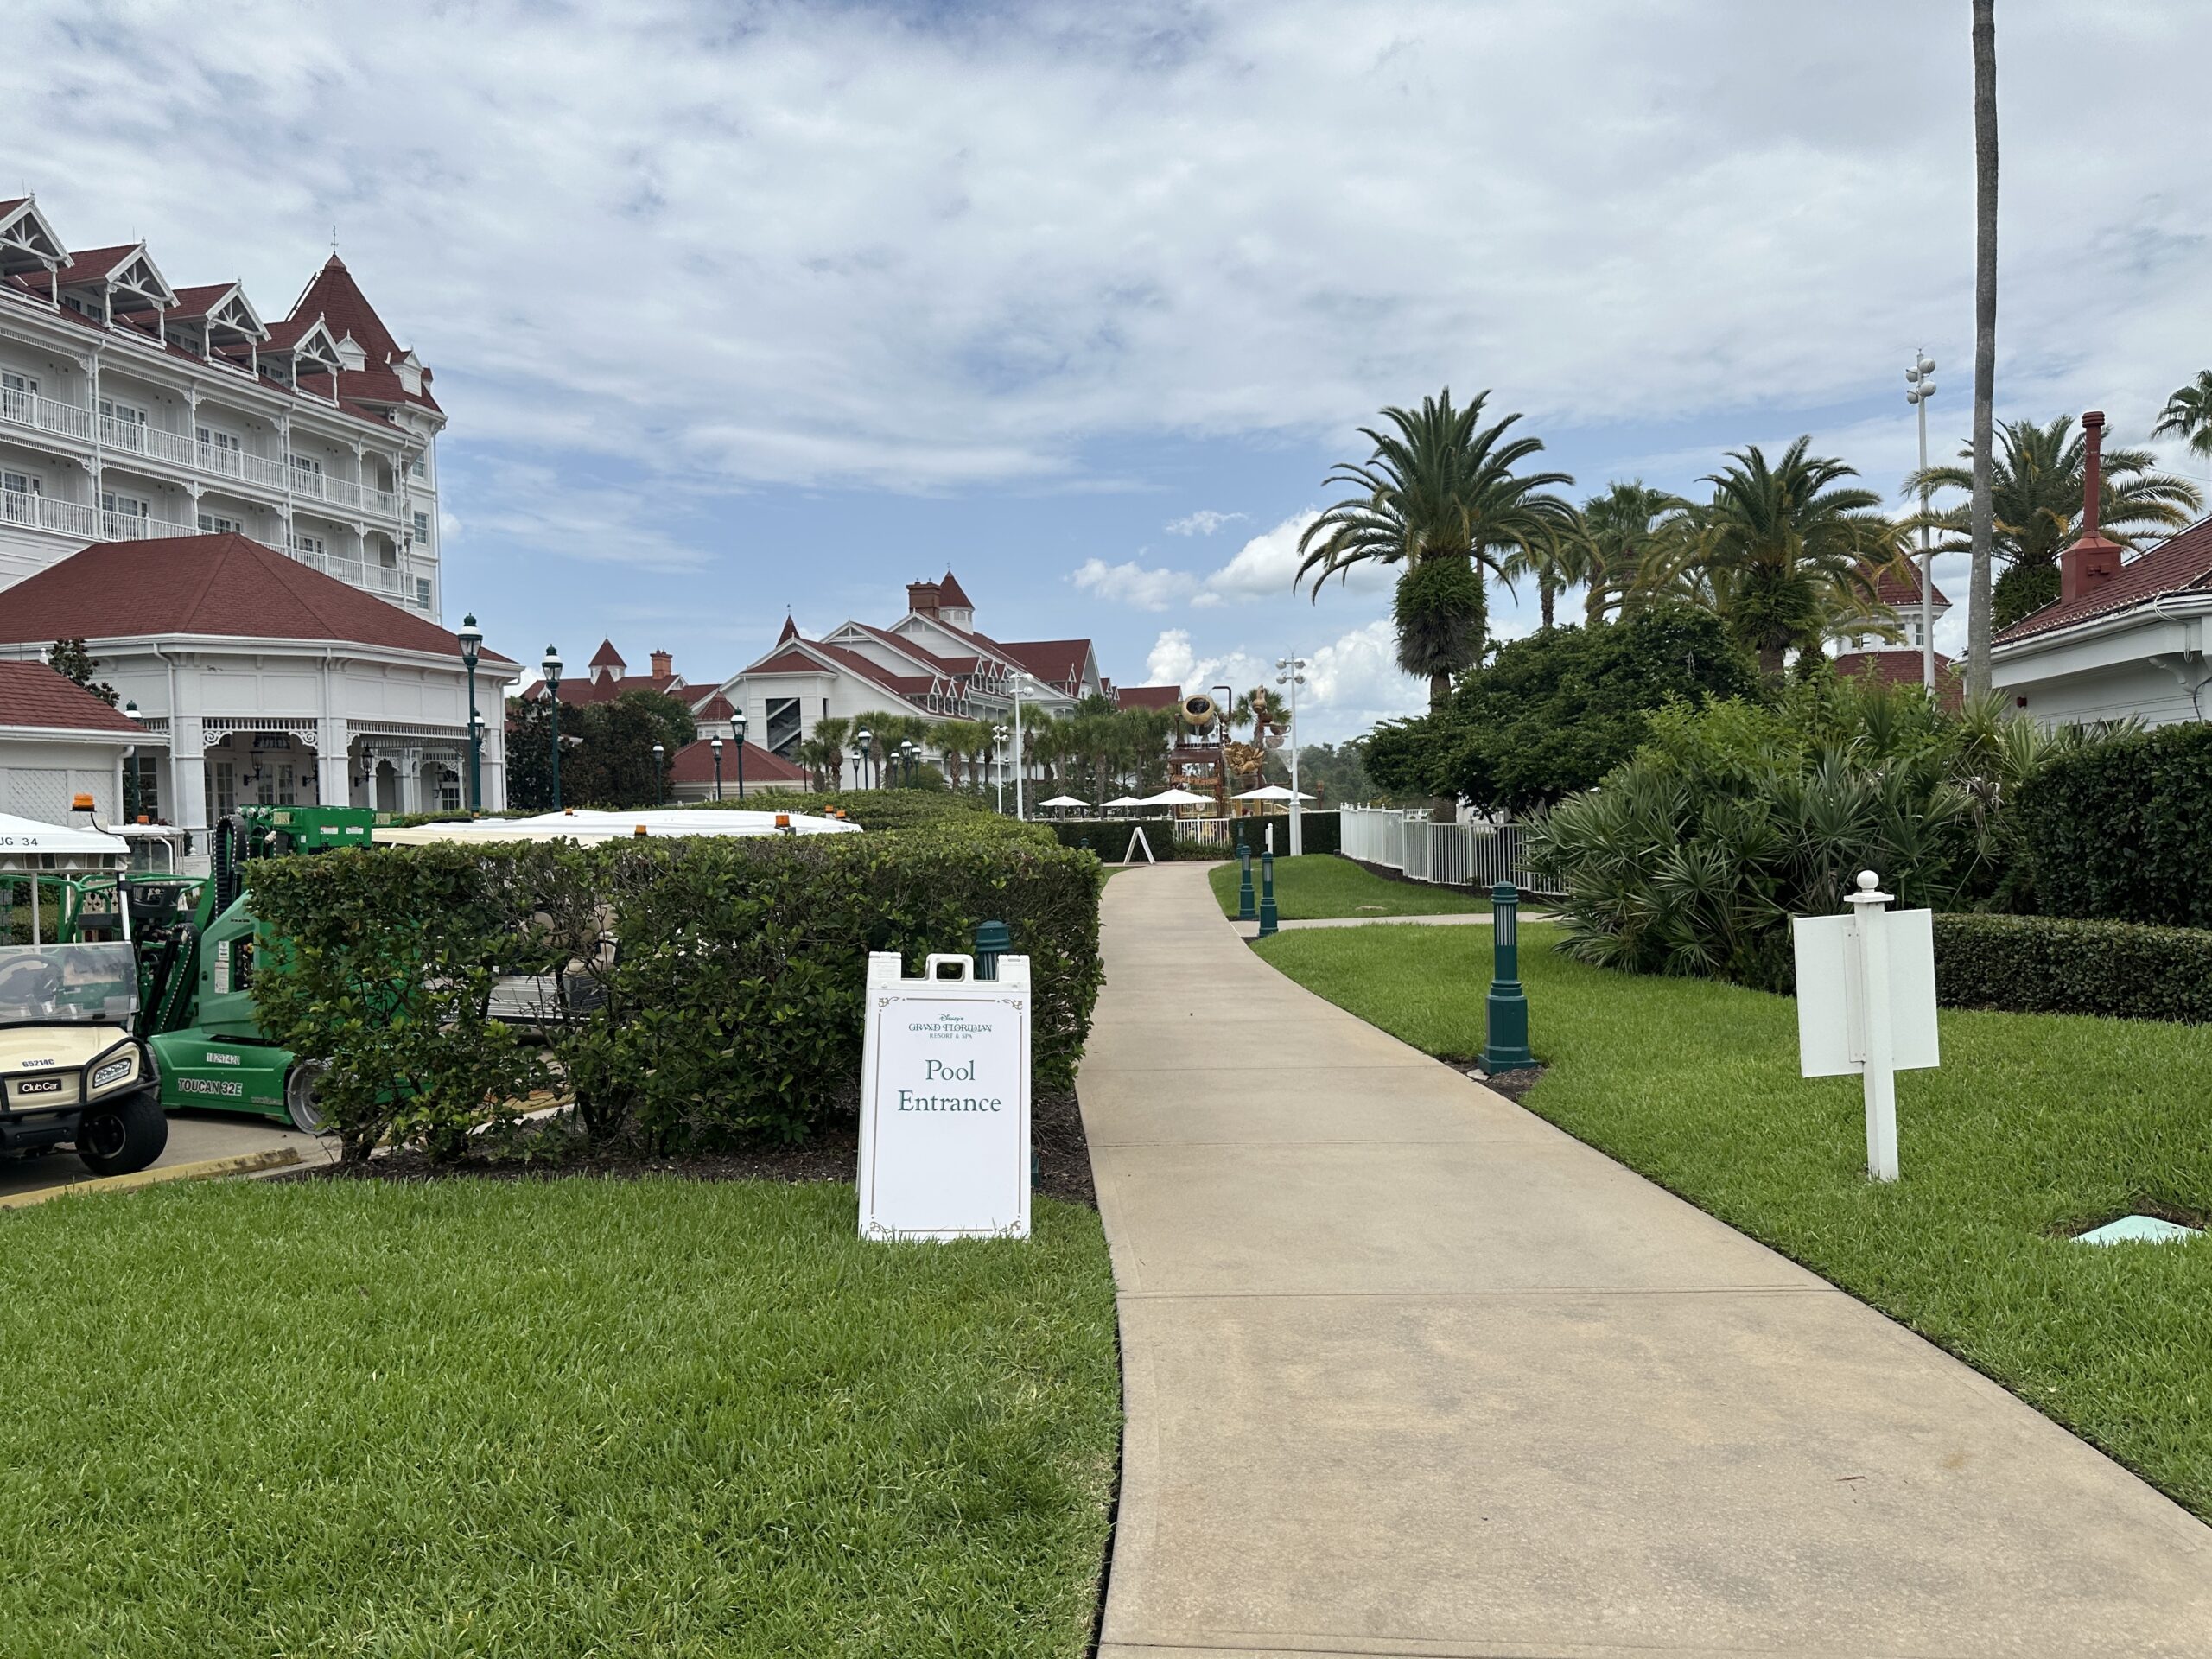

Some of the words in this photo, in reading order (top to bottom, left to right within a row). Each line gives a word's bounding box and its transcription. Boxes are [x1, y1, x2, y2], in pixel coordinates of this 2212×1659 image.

[22, 837, 38, 846] 34
[938, 1014, 964, 1023] Disney's
[908, 1023, 941, 1032] GRAND
[942, 1023, 993, 1033] FLORIDIAN
[925, 1059, 976, 1081] Pool
[178, 1078, 220, 1095] TOUCAN
[221, 1081, 243, 1096] 32E
[898, 1090, 1001, 1111] Entrance
